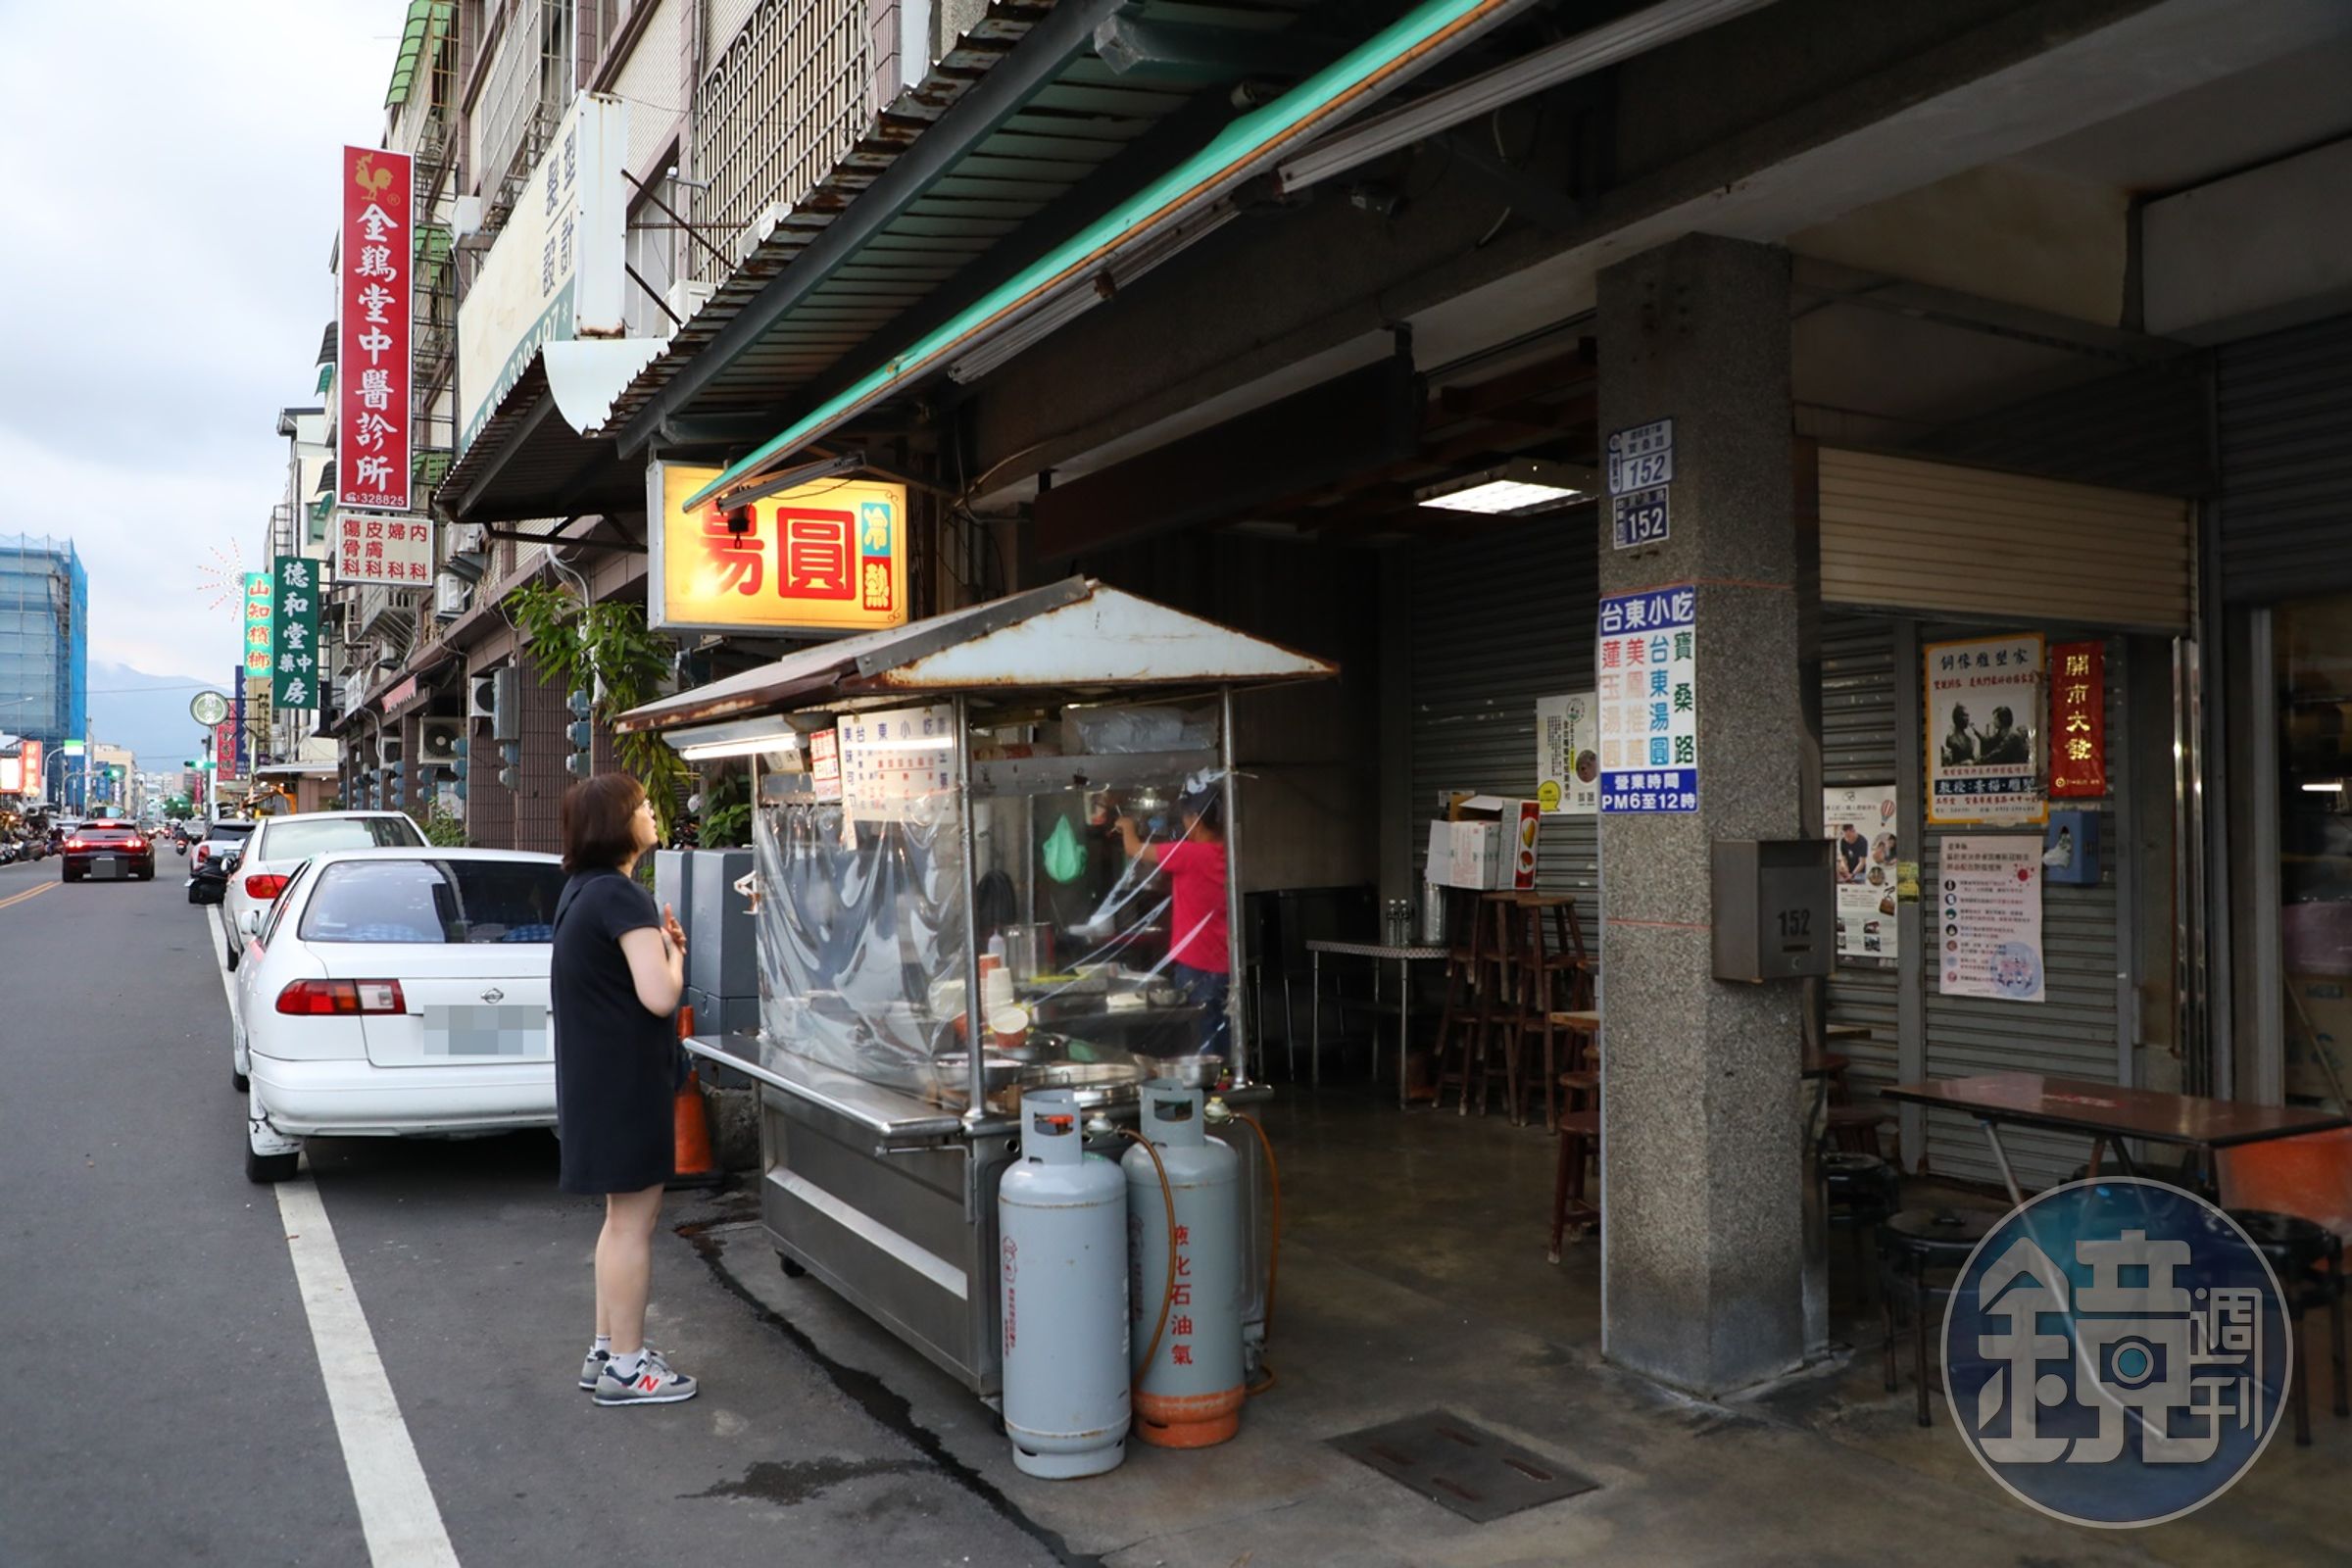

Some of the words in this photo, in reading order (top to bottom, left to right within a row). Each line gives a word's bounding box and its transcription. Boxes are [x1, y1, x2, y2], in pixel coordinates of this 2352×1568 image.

[1630, 455, 1666, 487] 152
[1628, 507, 1664, 542] 152
[343, 519, 362, 577] 傷骨科
[366, 521, 384, 578] 皮膚科
[387, 523, 406, 579] 婦科
[1600, 591, 1694, 632] 台東小吃
[1649, 635, 1670, 765] 台東湯圓
[1674, 631, 1694, 764] 寶桑路
[2065, 654, 2093, 761] 開市大發
[857, 717, 933, 743] 台東小吃
[1601, 792, 1695, 810] PM6至12時
[1614, 771, 1681, 792] 營業時間
[1777, 908, 1811, 937] 152
[1169, 1224, 1193, 1365] 液化石油氣
[638, 1374, 660, 1393] N
